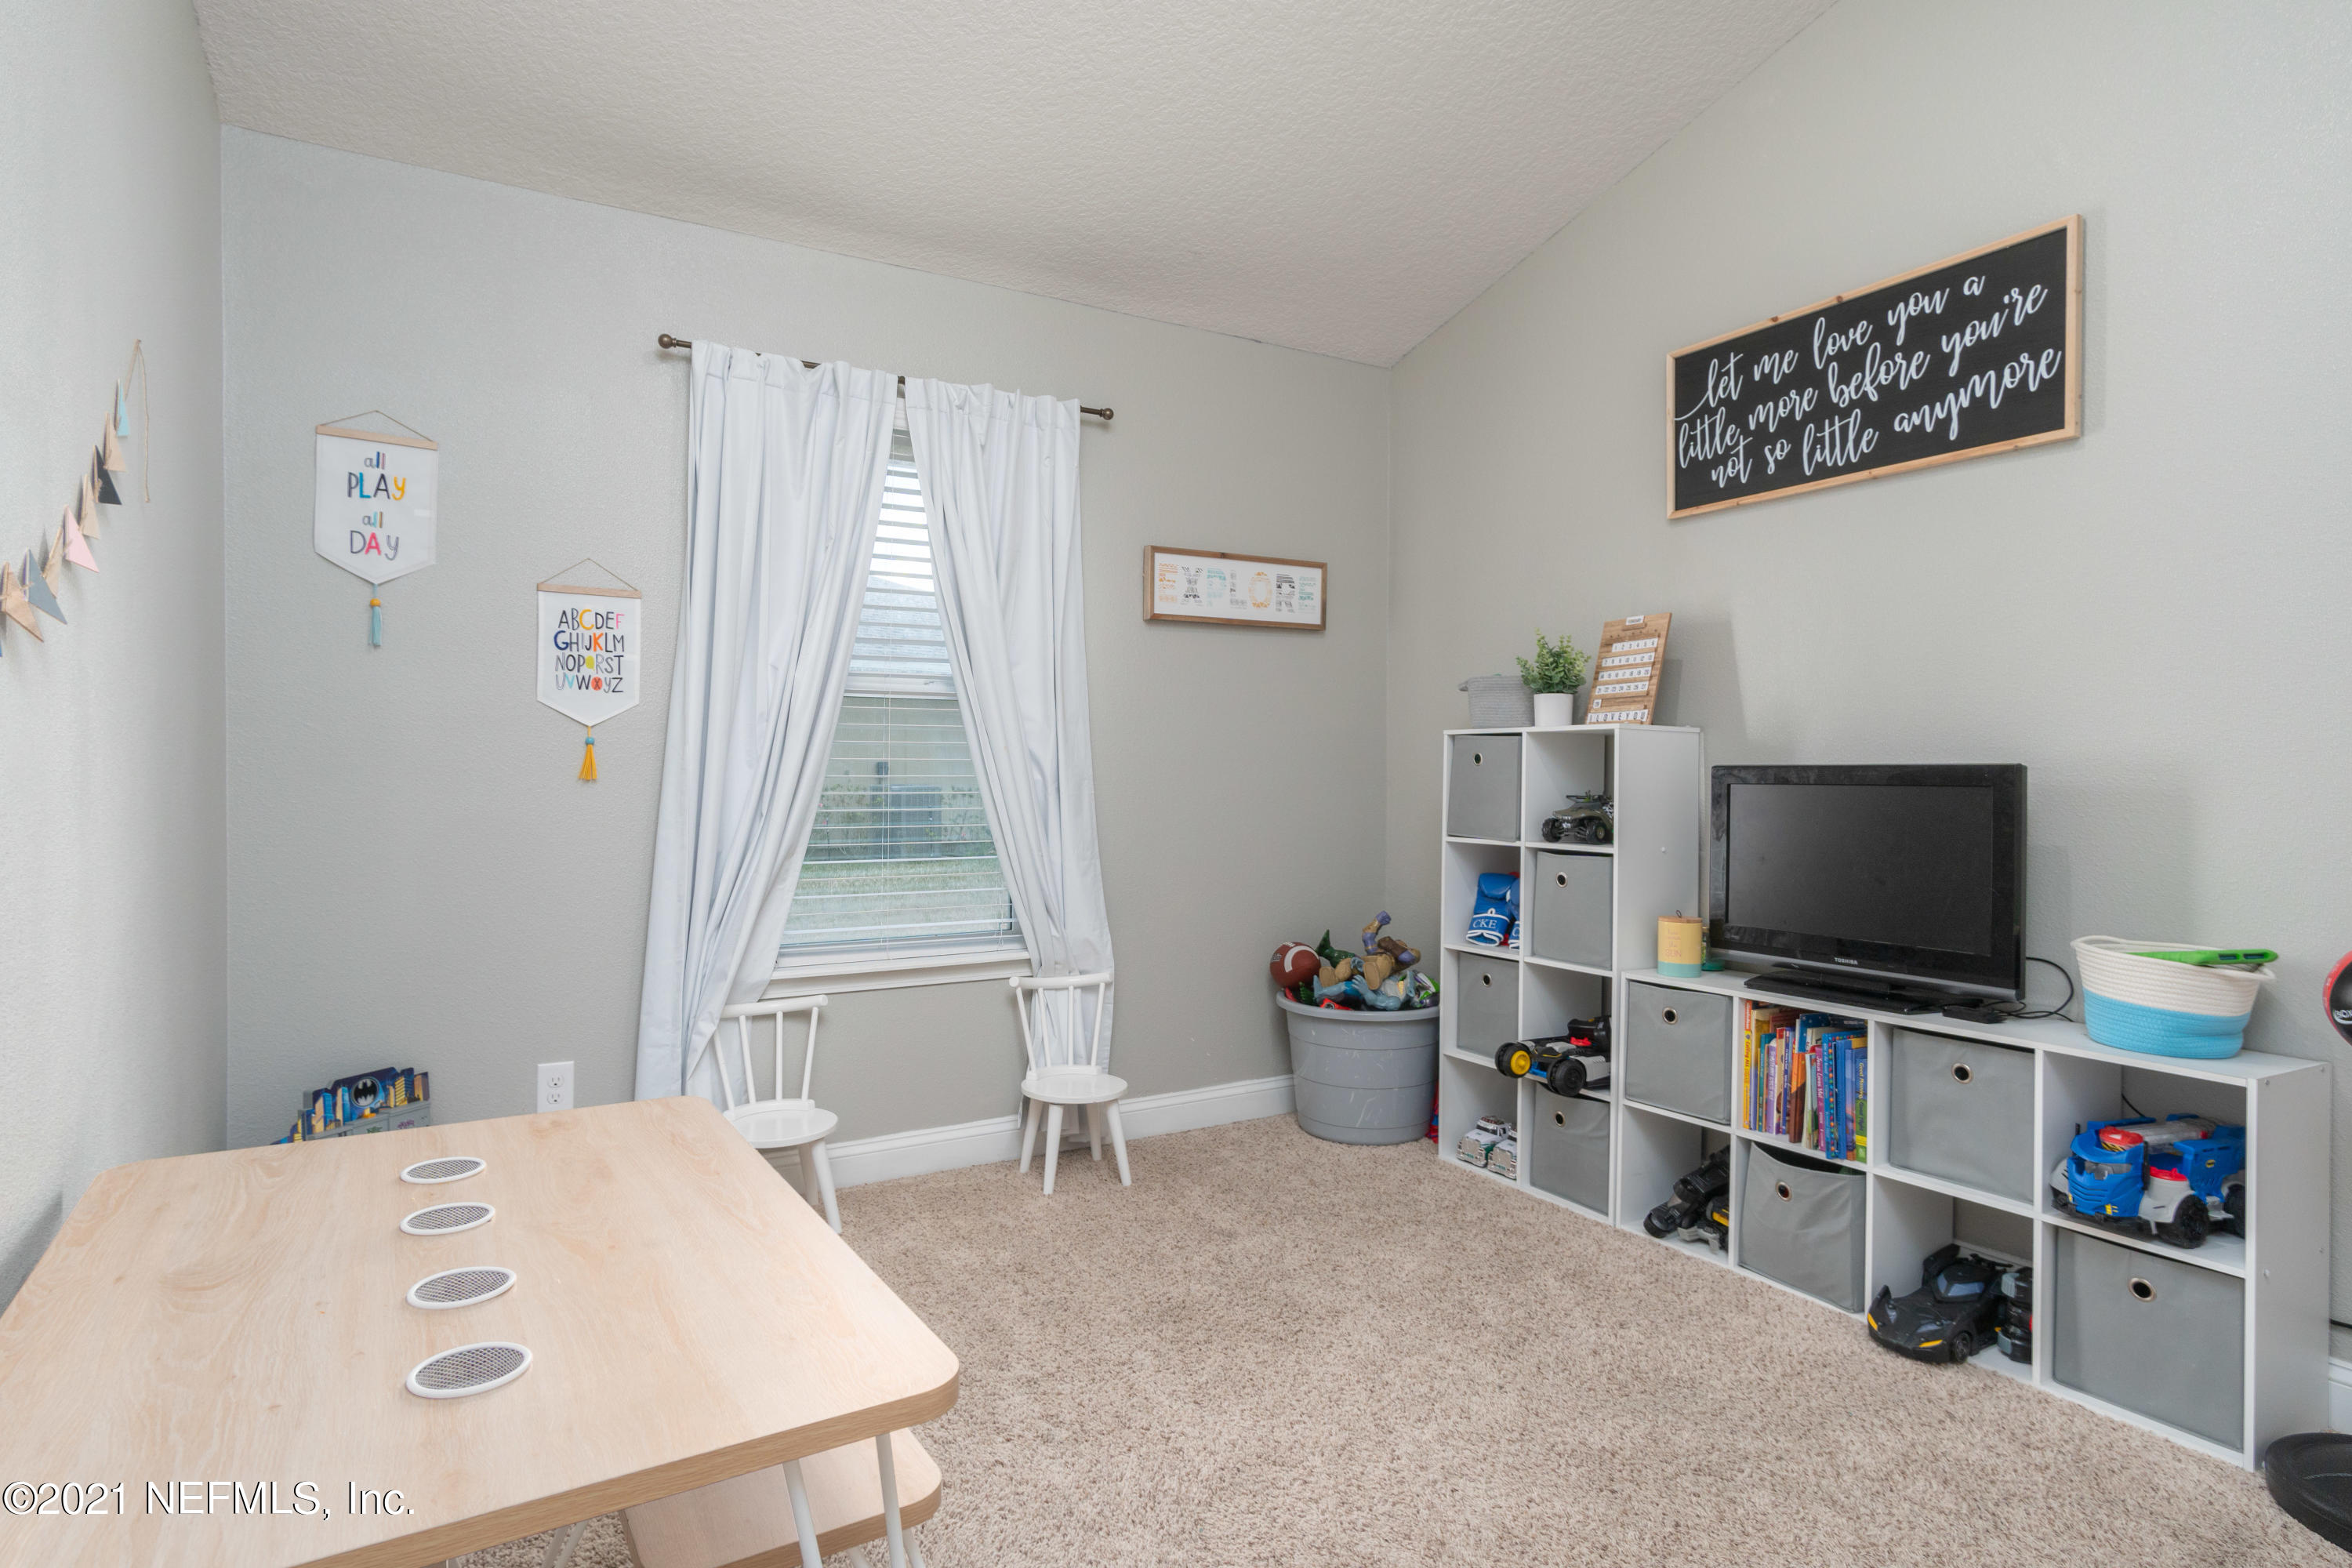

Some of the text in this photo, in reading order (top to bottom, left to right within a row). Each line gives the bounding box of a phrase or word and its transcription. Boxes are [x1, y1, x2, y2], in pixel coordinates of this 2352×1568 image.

[1679, 284, 2048, 469] little more before you're
[1754, 349, 1798, 384] me
[1813, 318, 1873, 369] love
[1887, 288, 1950, 346] you
[1963, 275, 1985, 296] a
[364, 452, 386, 470] all
[1711, 348, 2062, 488] not so little anymore
[362, 511, 383, 528] all
